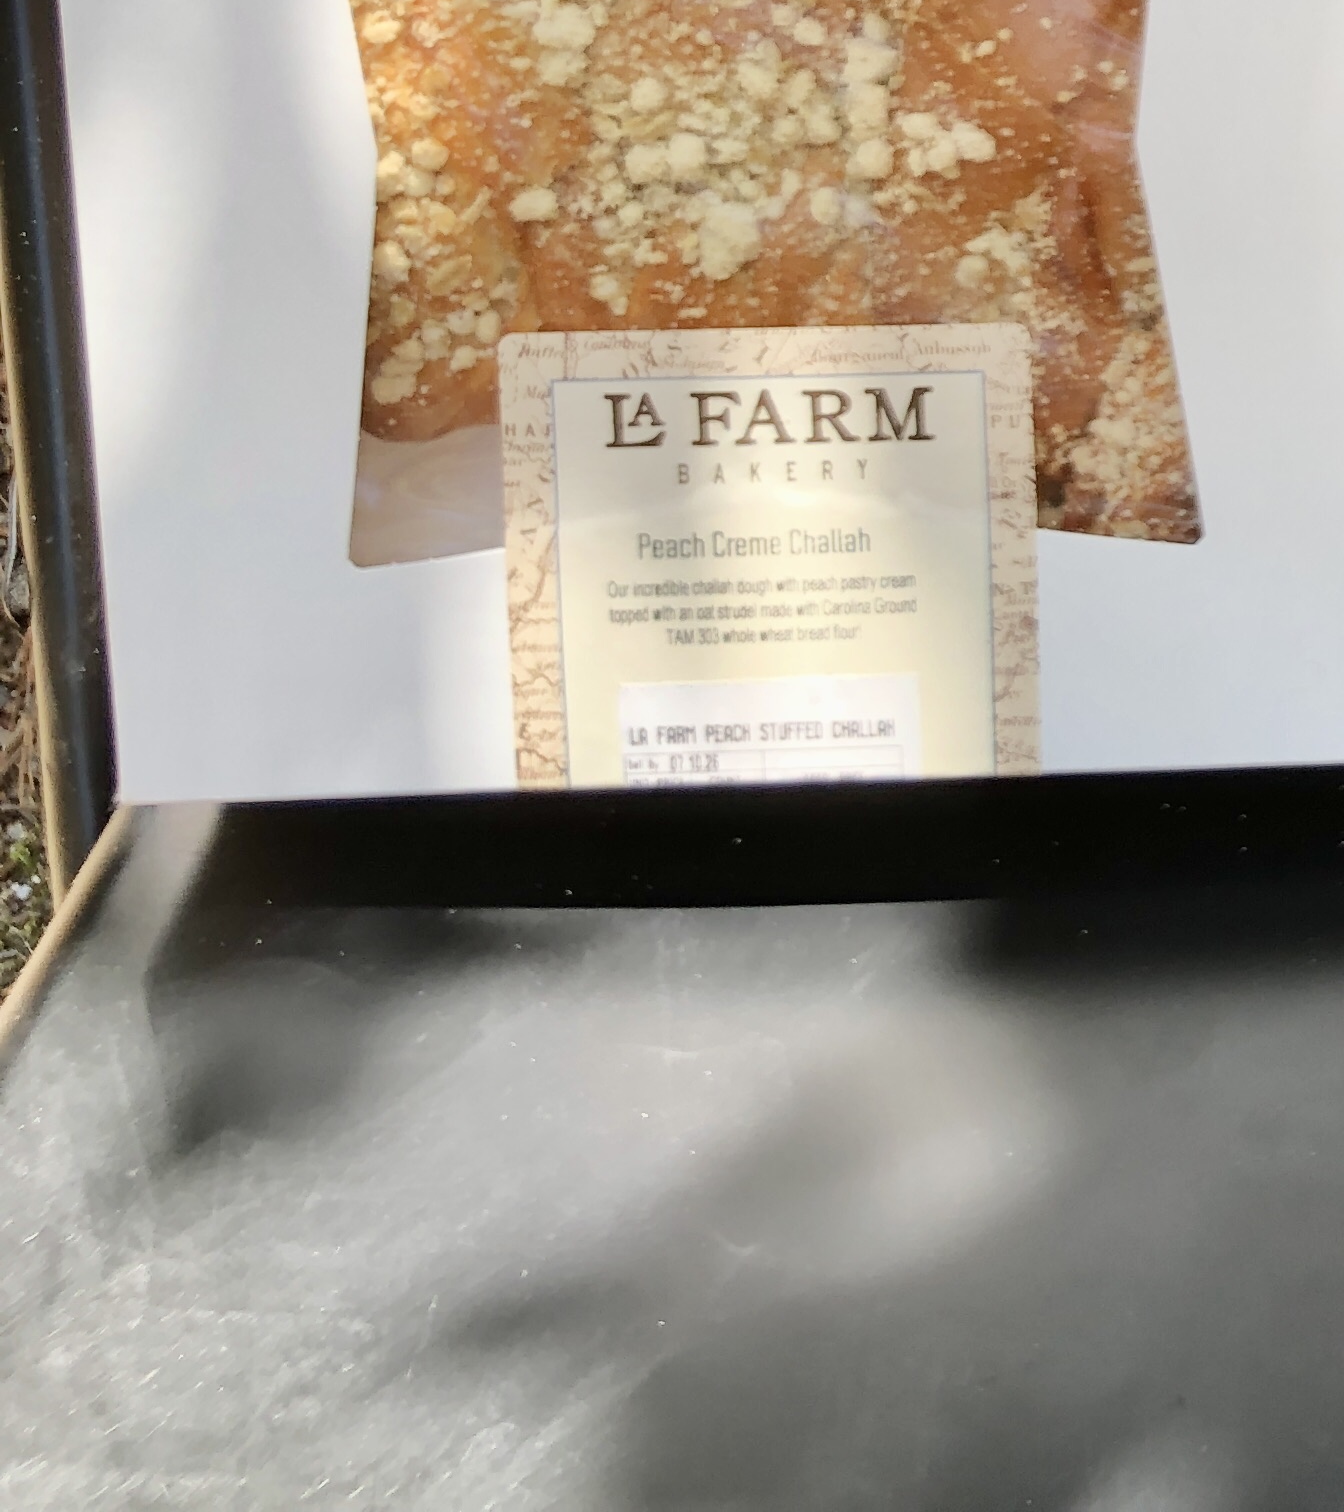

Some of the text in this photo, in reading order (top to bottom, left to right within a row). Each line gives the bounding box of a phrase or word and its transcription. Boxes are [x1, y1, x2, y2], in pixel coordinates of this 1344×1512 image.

[604, 386, 935, 448] LA FARM
[678, 459, 869, 485] BAKERY
[637, 527, 871, 559] Peach Creme Challah
[608, 581, 628, 597] Our
[776, 577, 800, 593] with
[802, 575, 839, 595] peach
[609, 606, 649, 626] topped
[652, 605, 677, 622] with
[796, 601, 819, 617] with
[873, 597, 918, 615] Ground
[628, 719, 895, 746] LA FARM PEACH STUFFED CHALLAH
